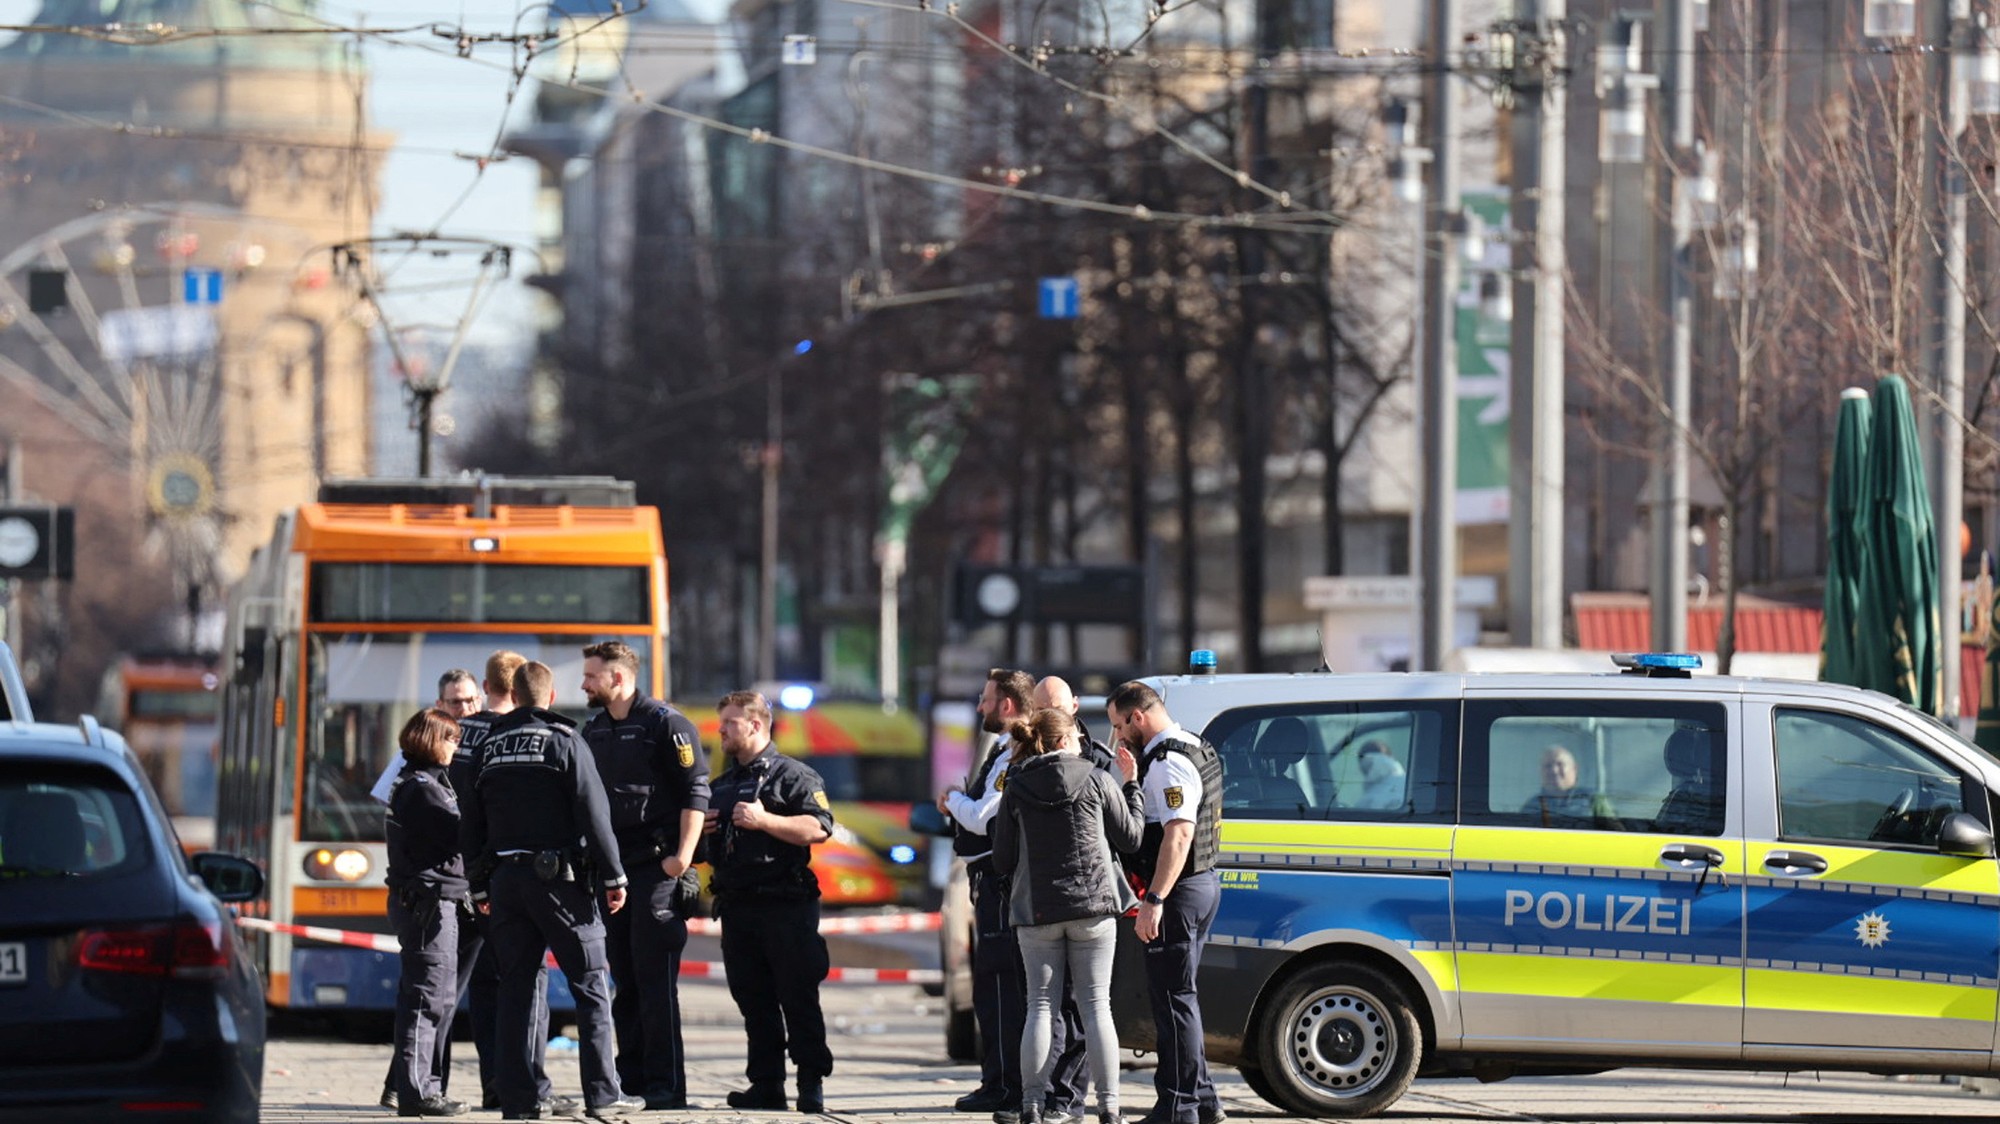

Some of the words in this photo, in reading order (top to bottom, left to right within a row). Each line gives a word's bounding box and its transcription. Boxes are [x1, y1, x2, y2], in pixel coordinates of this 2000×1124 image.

[482, 735, 548, 762] POLIZEI
[1504, 889, 1692, 936] POLIZEI
[0, 948, 22, 975] 1
